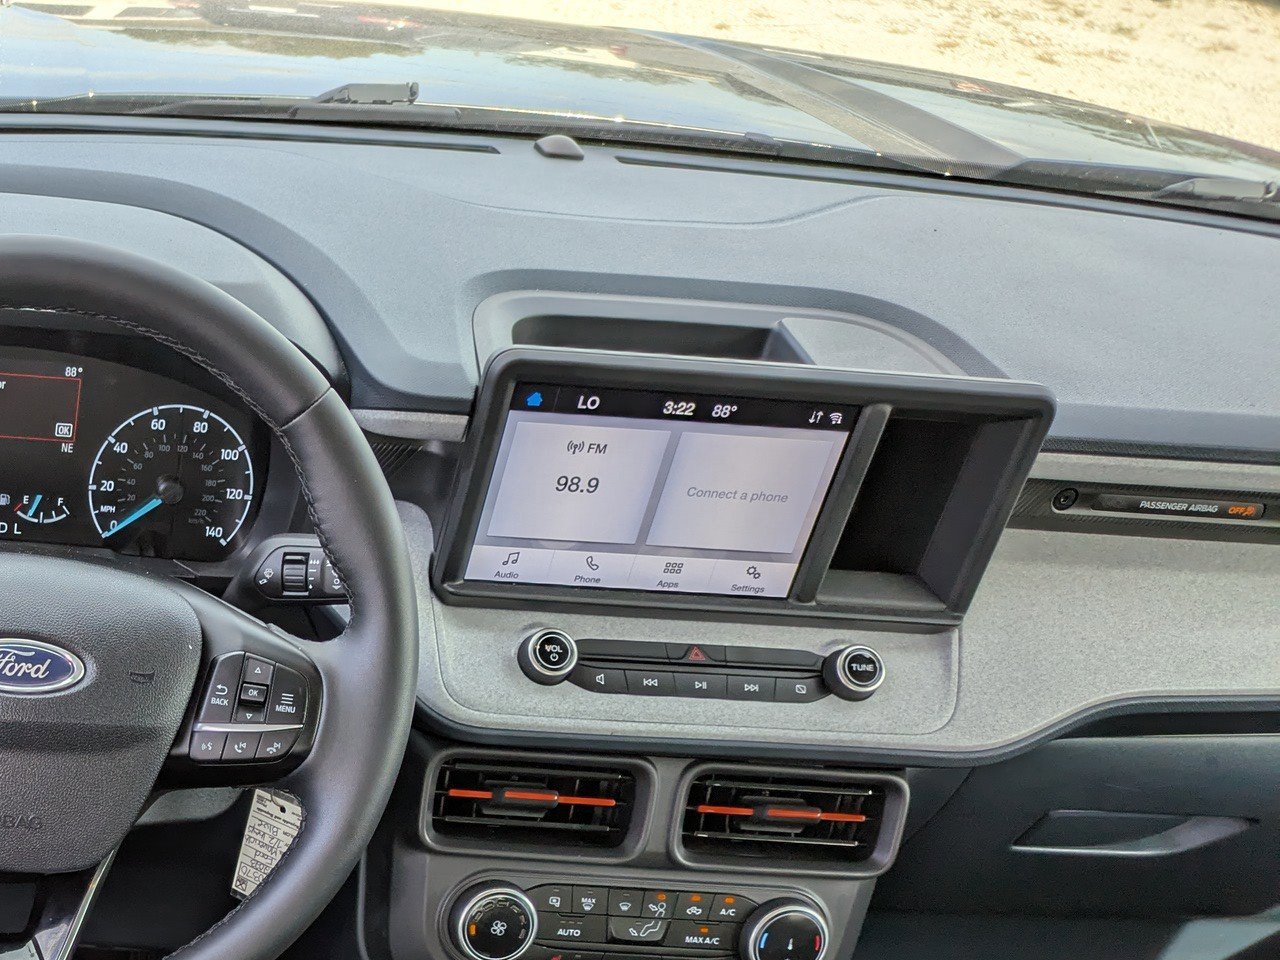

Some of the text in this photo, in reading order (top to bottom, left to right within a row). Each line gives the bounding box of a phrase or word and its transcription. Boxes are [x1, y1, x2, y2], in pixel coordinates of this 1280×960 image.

[577, 396, 600, 410] LO
[663, 401, 696, 416] 3:22
[711, 404, 738, 418] 88°
[151, 419, 166, 430] 60
[193, 422, 208, 434] 80
[58, 426, 70, 435] OK
[61, 443, 73, 453] NE
[113, 442, 128, 454] 40
[587, 443, 607, 454] FM
[221, 449, 239, 461] 100
[100, 481, 114, 492] 20
[555, 475, 599, 494] 98.9
[226, 488, 243, 500] 120
[687, 486, 788, 504] Connect a phone
[23, 496, 29, 505] E
[57, 498, 64, 506] F
[100, 505, 116, 513] MPH
[1140, 501, 1187, 511] PASSENGER
[1188, 504, 1218, 513] AIRBAG
[205, 526, 223, 538] 140
[494, 570, 519, 580] Audio
[574, 574, 601, 584] Phone
[656, 580, 679, 590] Apps
[731, 583, 765, 594] Settings
[545, 644, 563, 654] VOL
[851, 662, 875, 673] TUNE
[248, 689, 258, 697] OK
[211, 697, 229, 706] BACK
[275, 705, 296, 713] MENU
[720, 908, 736, 916] A/C
[557, 928, 581, 937] AUTO
[685, 936, 720, 945] MAX A/C
